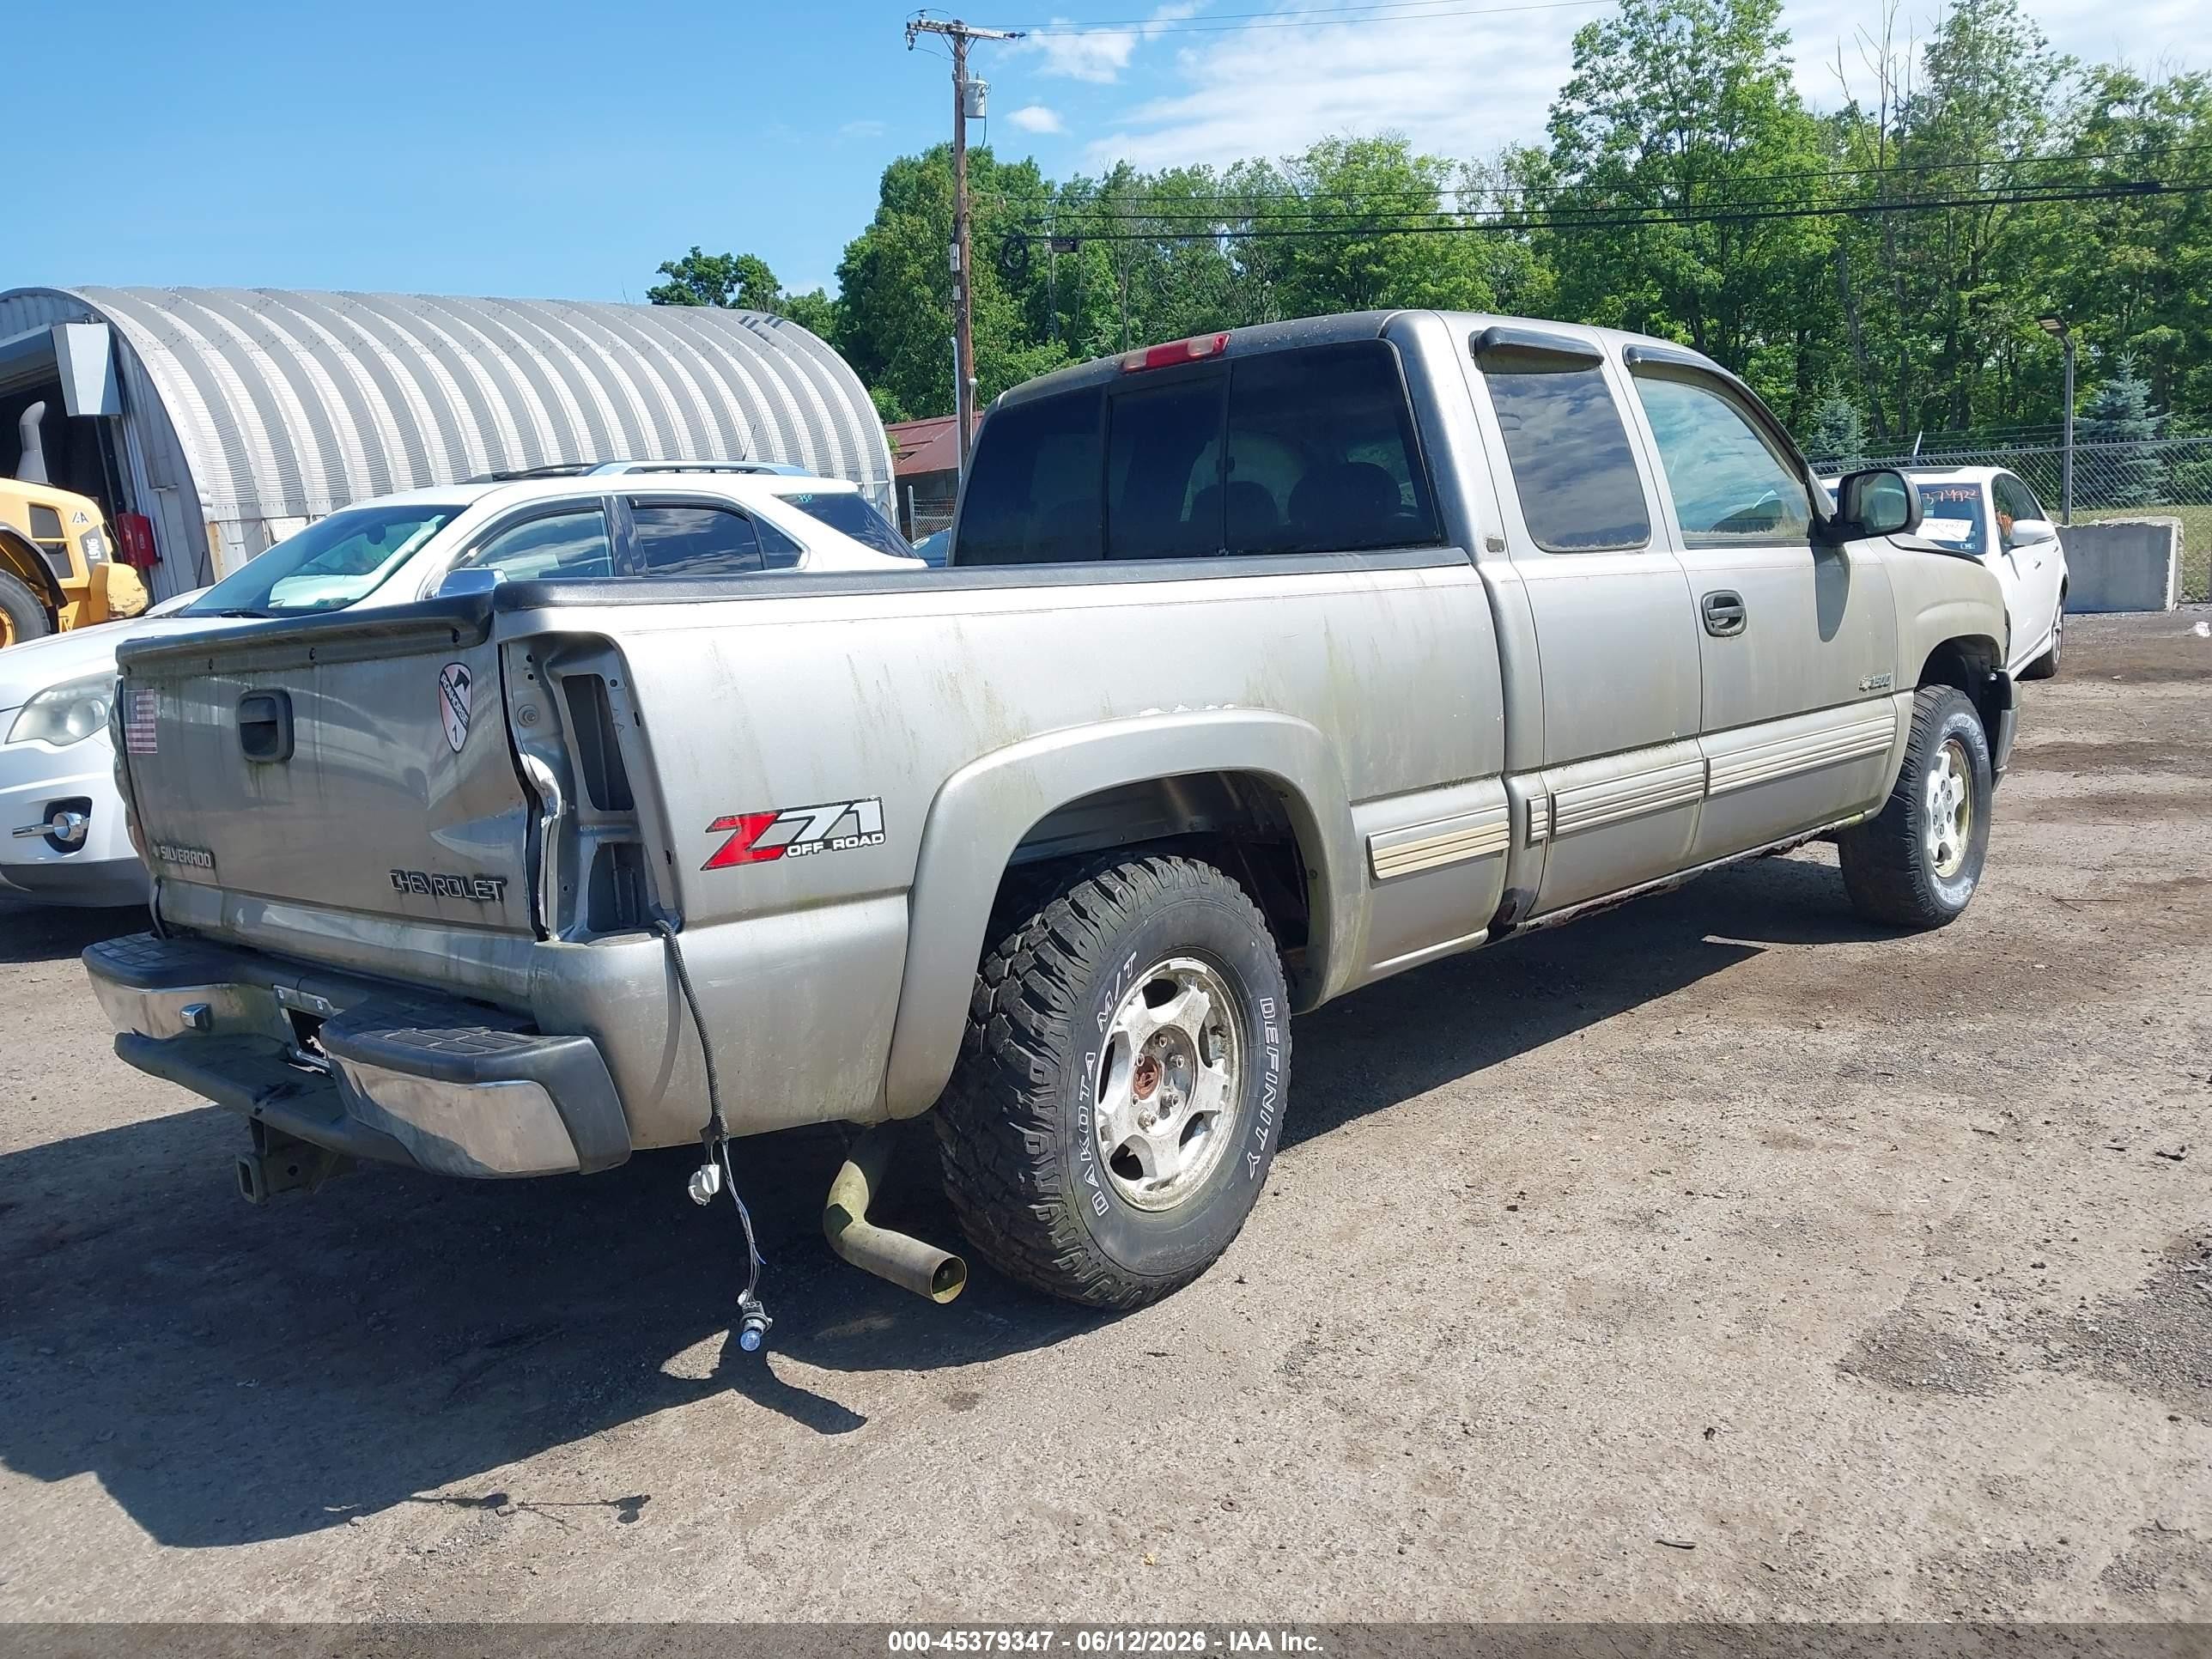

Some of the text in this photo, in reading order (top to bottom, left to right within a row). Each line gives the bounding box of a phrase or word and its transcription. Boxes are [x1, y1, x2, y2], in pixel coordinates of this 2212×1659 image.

[452, 724, 458, 744] 1
[699, 796, 885, 871] Z71
[787, 832, 886, 858] OFF ROAD
[161, 846, 212, 867] SILVERADO
[389, 870, 504, 900] CHEVROLET
[1073, 951, 1138, 1217] DAKOTA M/T
[1247, 996, 1284, 1181] DEFINITY
